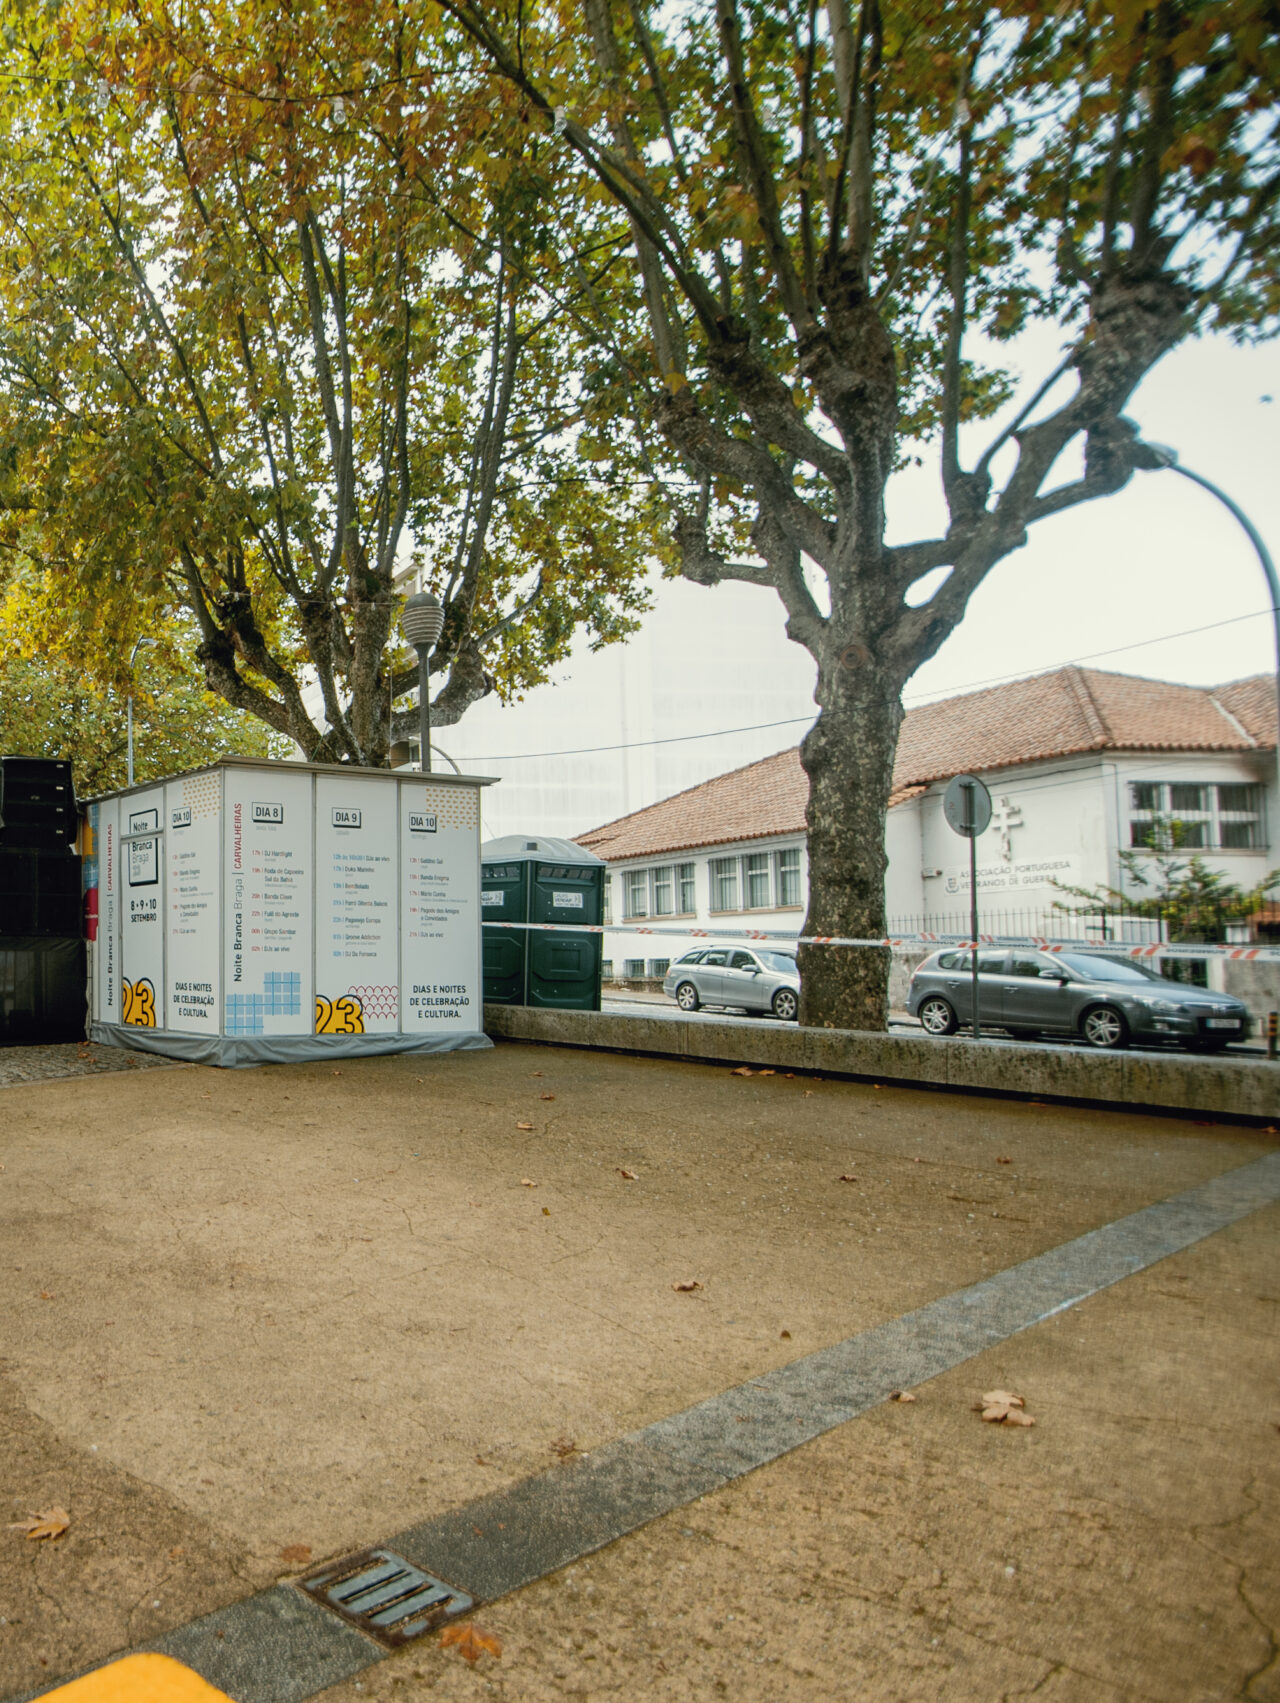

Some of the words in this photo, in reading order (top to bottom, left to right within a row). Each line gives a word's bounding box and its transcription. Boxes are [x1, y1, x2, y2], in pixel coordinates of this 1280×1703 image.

[183, 811, 190, 821] 10
[256, 807, 271, 817] DIA
[273, 808, 279, 818] 8
[335, 812, 350, 822] DIA
[352, 813, 357, 822] 9
[133, 822, 148, 832] Noite
[411, 816, 424, 826] DIA
[425, 818, 434, 827] 10
[234, 803, 242, 869] CARVALHEIRAS
[132, 841, 153, 852] Branca
[960, 866, 1011, 878] ASOCIAÇÃO
[1015, 861, 1071, 873] PORTUGUESA
[960, 878, 1006, 889] VERANOS
[234, 879, 244, 910] Braga
[131, 900, 135, 911] 8
[140, 899, 144, 910] 9
[149, 898, 157, 910] 10
[131, 913, 157, 923] SETEMBRO
[234, 913, 242, 950] Branca
[234, 954, 242, 982] Noite
[175, 982, 188, 991] DIAS
[188, 983, 192, 991] E
[193, 983, 212, 992] NOITES
[413, 985, 431, 994] DIAS
[433, 985, 438, 994] E
[439, 985, 467, 994] NOITES
[173, 994, 180, 1003] DE
[181, 994, 214, 1007] CELEBRAÇÃO
[410, 997, 420, 1006] DE
[422, 995, 470, 1007] CELEBRAÇÃO
[178, 1007, 182, 1016] E
[418, 1010, 423, 1018] E
[424, 1010, 462, 1018] CULTURA.
